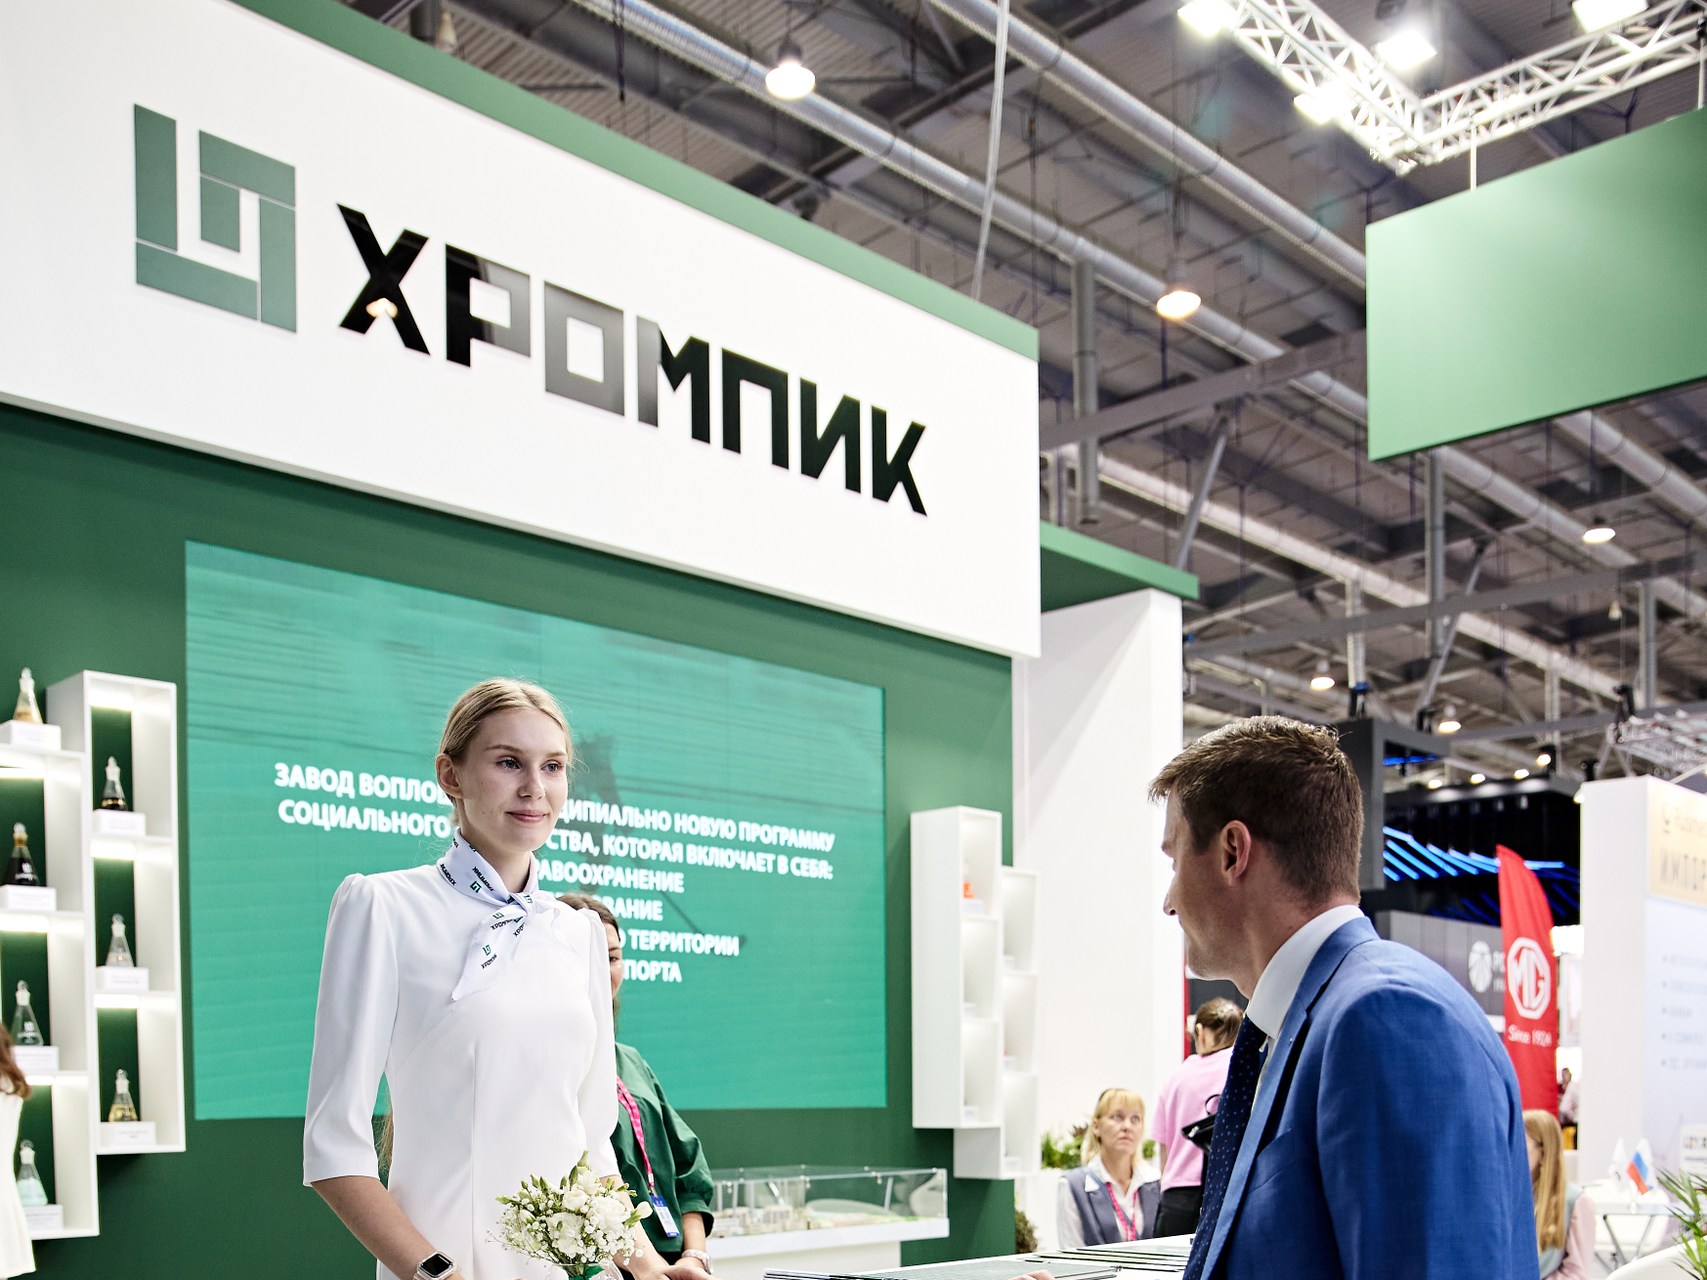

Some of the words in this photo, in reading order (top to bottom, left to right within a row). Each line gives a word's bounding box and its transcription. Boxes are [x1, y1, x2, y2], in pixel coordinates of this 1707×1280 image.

[337, 203, 927, 516] ХРОМПИК
[274, 762, 355, 799] ЗАВОД
[559, 799, 671, 831] ЦИПИАЛЬНО
[674, 813, 737, 841] НОВУЮ
[738, 821, 836, 852] ПРОГРАММУ
[278, 799, 451, 838] СОЦИАЛЬНОГО
[545, 828, 600, 857] СТВА,
[603, 835, 684, 863] КОТОРАЯ
[686, 844, 776, 873] ВКЛЮЧАЕТ
[777, 854, 789, 875] В
[789, 856, 834, 880] СЕБЯ:
[534, 859, 684, 893] АВООХРАНЕНИЕ
[627, 928, 740, 956] ТЕРРИТОРИИ
[623, 959, 682, 982] ПОРТА
[1508, 1024, 1531, 1044] Since
